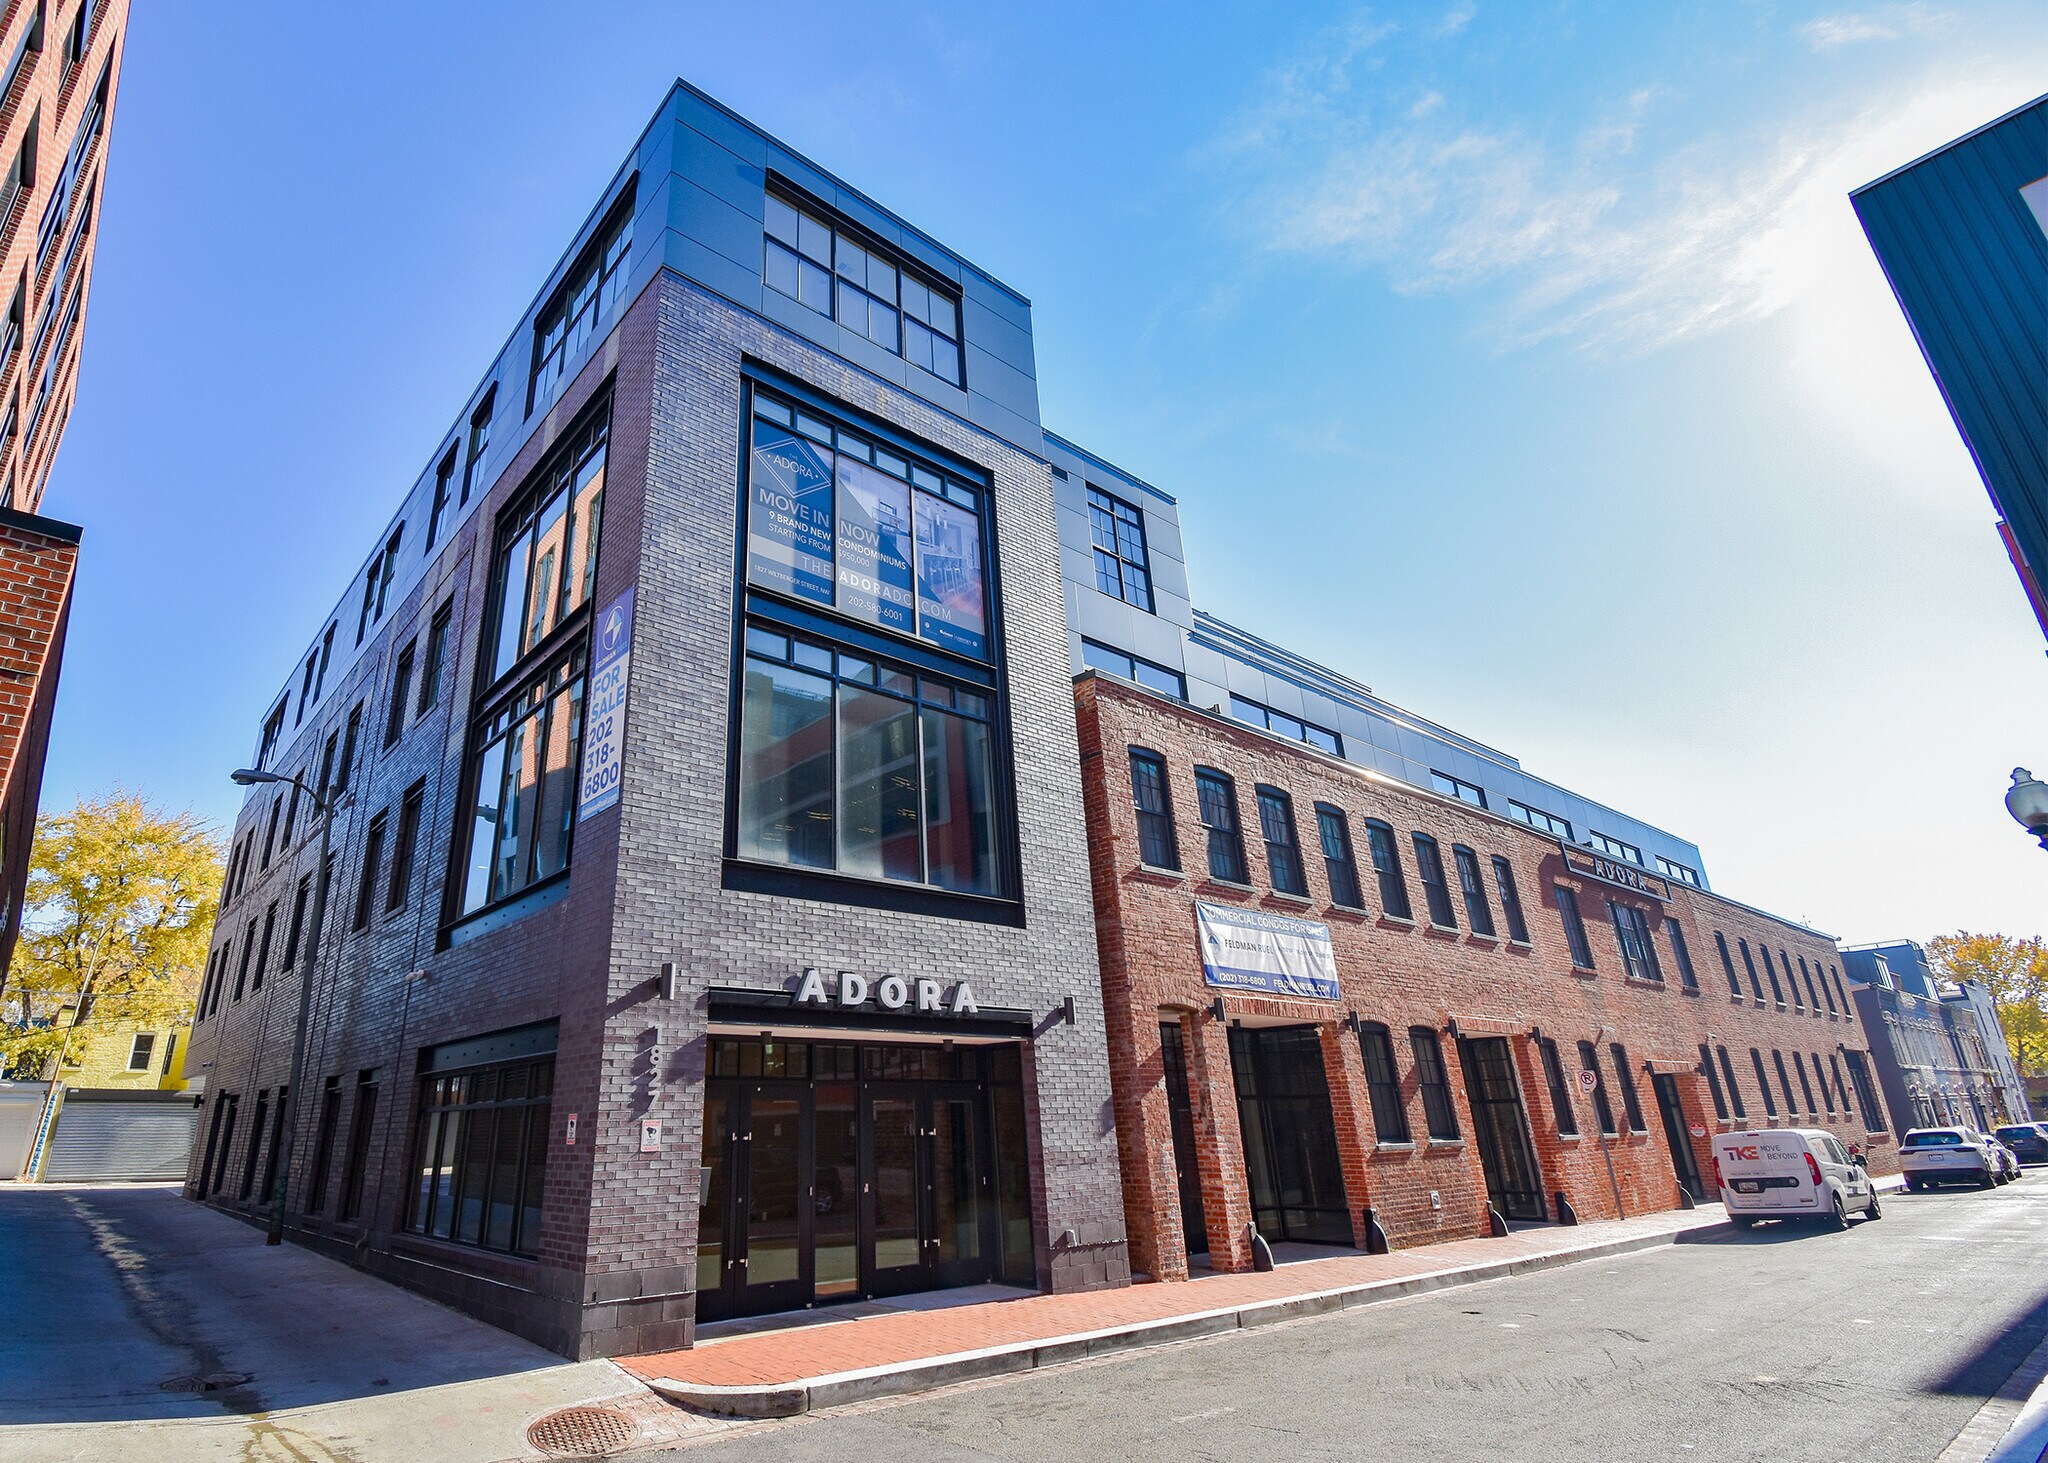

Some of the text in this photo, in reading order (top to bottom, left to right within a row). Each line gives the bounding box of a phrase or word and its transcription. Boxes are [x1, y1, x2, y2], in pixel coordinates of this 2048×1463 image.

[774, 455, 814, 480] ADORA
[760, 488, 880, 546] MOVE IN NOW
[769, 510, 907, 570] 9 BRAND NEW CONDOMINIUMS
[769, 524, 870, 567] STARTING FROM $950,000
[754, 564, 768, 575] 1827
[801, 555, 831, 577] THE
[848, 595, 903, 621] 202-580-6001
[594, 665, 620, 700] FOR
[591, 683, 625, 724] SALE
[589, 716, 614, 749] 202
[587, 743, 615, 774] 318-
[584, 761, 619, 799] 6800
[1594, 858, 1647, 890] ADORA
[1207, 907, 1257, 926] OMMERCIAL
[1258, 917, 1290, 931] CONDOS
[1290, 924, 1307, 933] FOR
[1224, 939, 1257, 953] FELDMAN
[1257, 945, 1274, 955] RUEL
[798, 968, 978, 1013] ADORA
[1219, 972, 1238, 984] (202)
[648, 1021, 663, 1110] 1827
[1723, 1146, 1760, 1160] TKE
